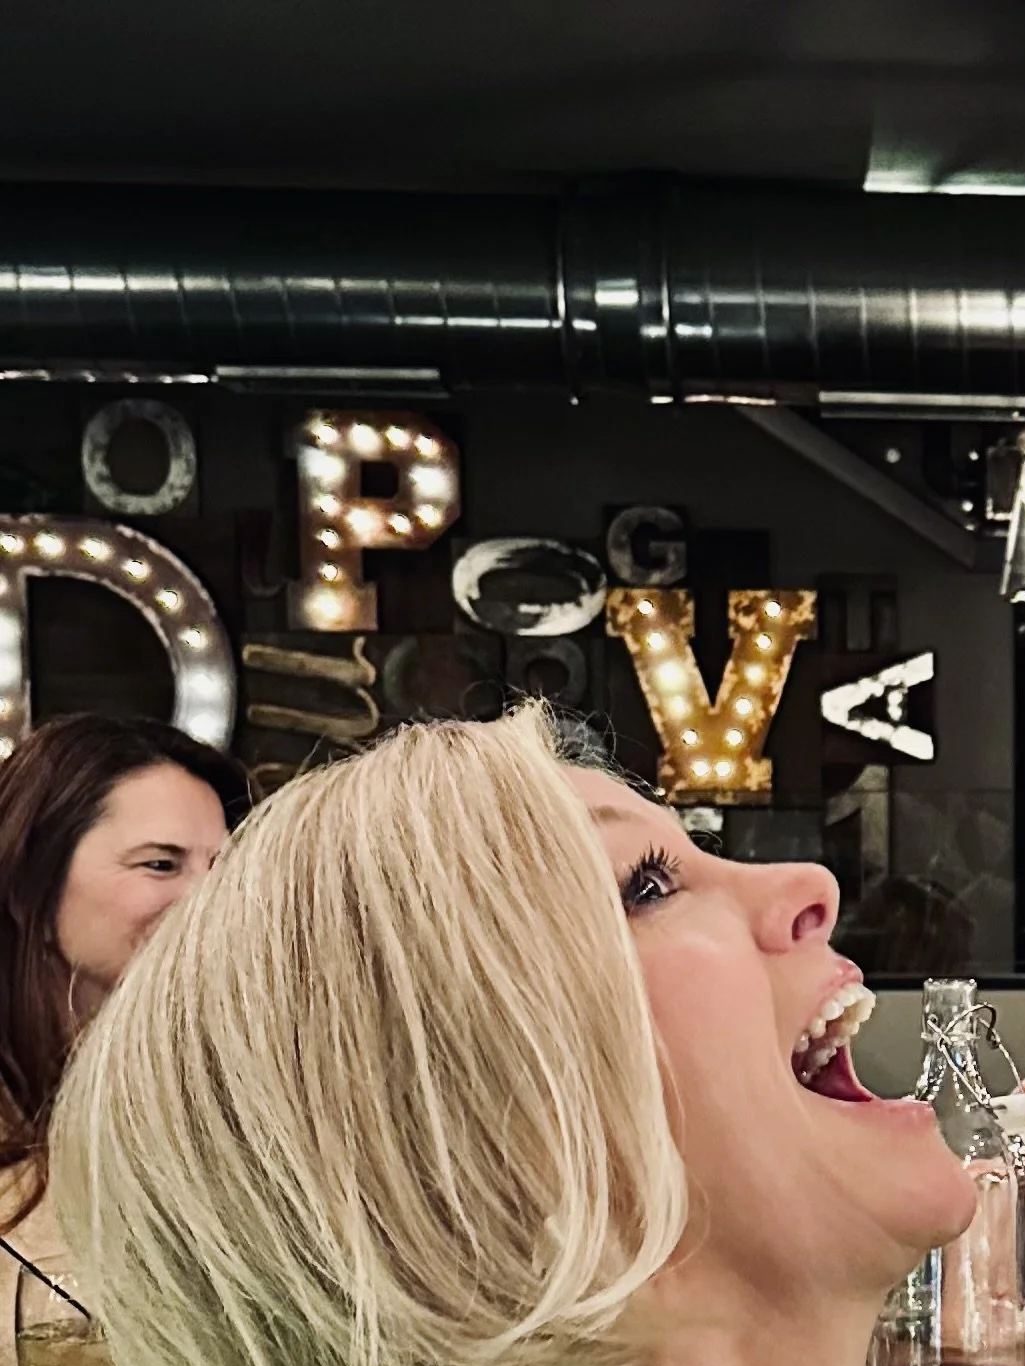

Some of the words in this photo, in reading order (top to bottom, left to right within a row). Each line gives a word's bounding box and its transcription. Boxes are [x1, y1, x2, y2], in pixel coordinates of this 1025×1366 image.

[81, 398, 197, 516] O
[286, 409, 461, 632] P
[606, 505, 688, 586] G
[0, 511, 237, 755] D
[605, 588, 817, 806] V
[820, 651, 935, 761] A
